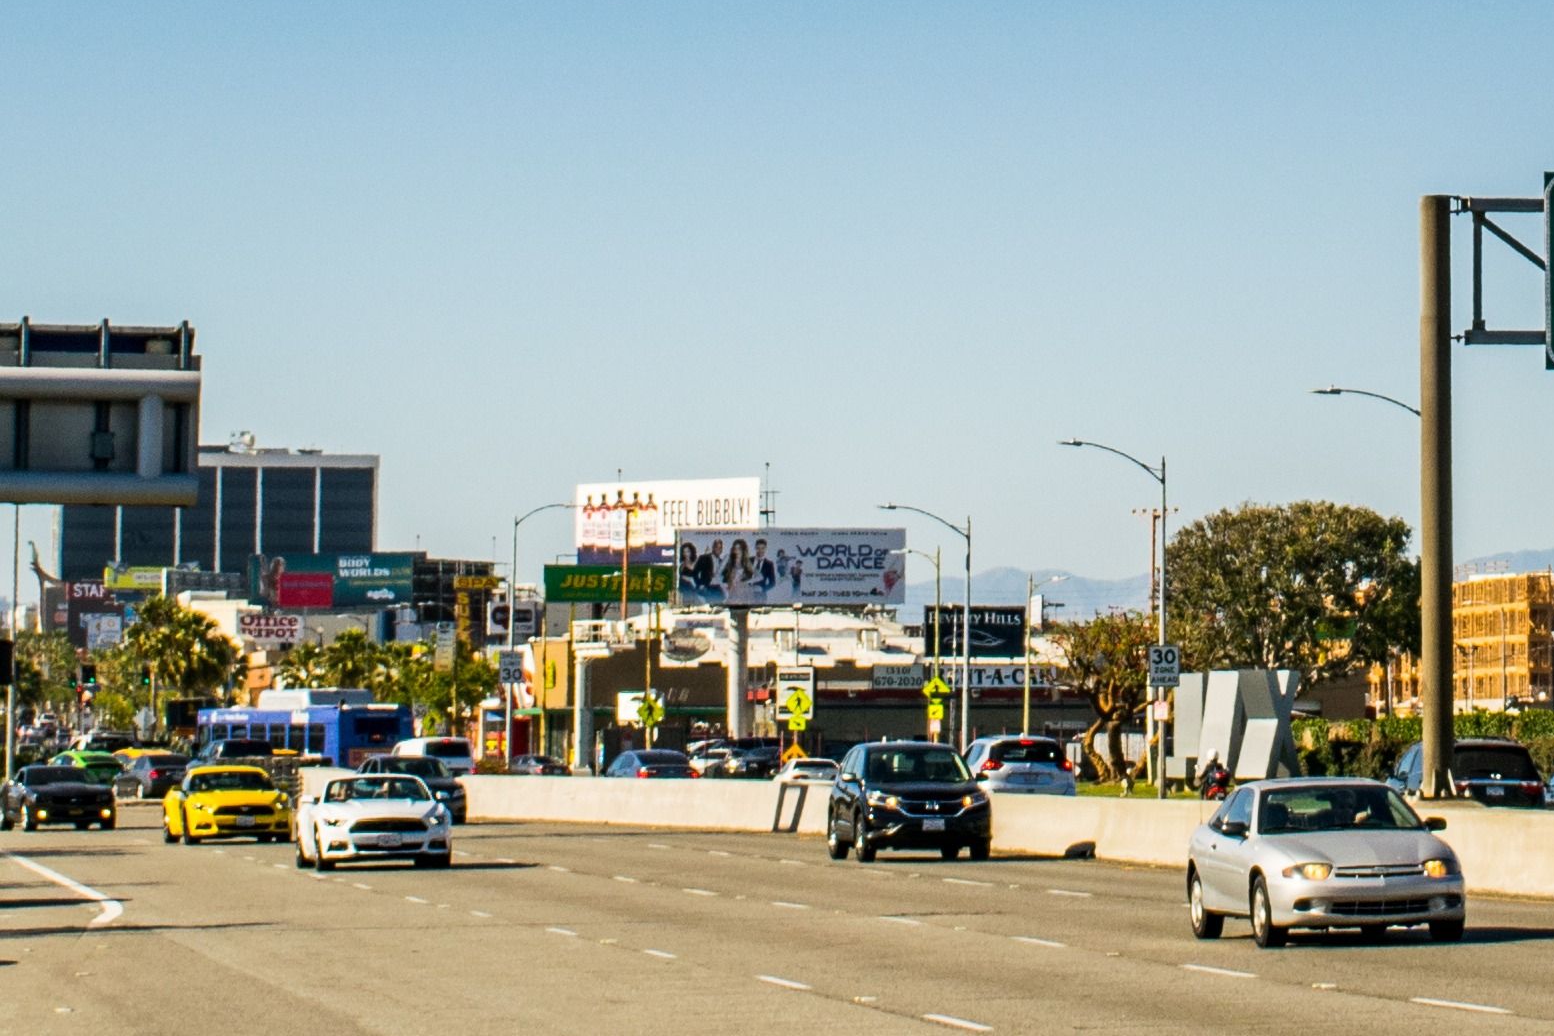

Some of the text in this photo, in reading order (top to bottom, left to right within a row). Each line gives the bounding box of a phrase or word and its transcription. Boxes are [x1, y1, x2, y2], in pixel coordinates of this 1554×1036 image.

[663, 498, 751, 527] FEEL BUBBLY!
[796, 544, 873, 557] WORLD
[338, 557, 371, 568] BODY
[817, 557, 886, 570] DANCE
[339, 568, 391, 578] WORLDS
[458, 577, 496, 589] SPA
[560, 575, 666, 592] JUST TRES
[240, 614, 299, 627] Office
[984, 611, 1022, 626] HILLS
[1152, 648, 1177, 665] 30
[502, 667, 522, 681] 30
[1154, 666, 1175, 674] ZONE
[1151, 675, 1178, 683] AHEAD
